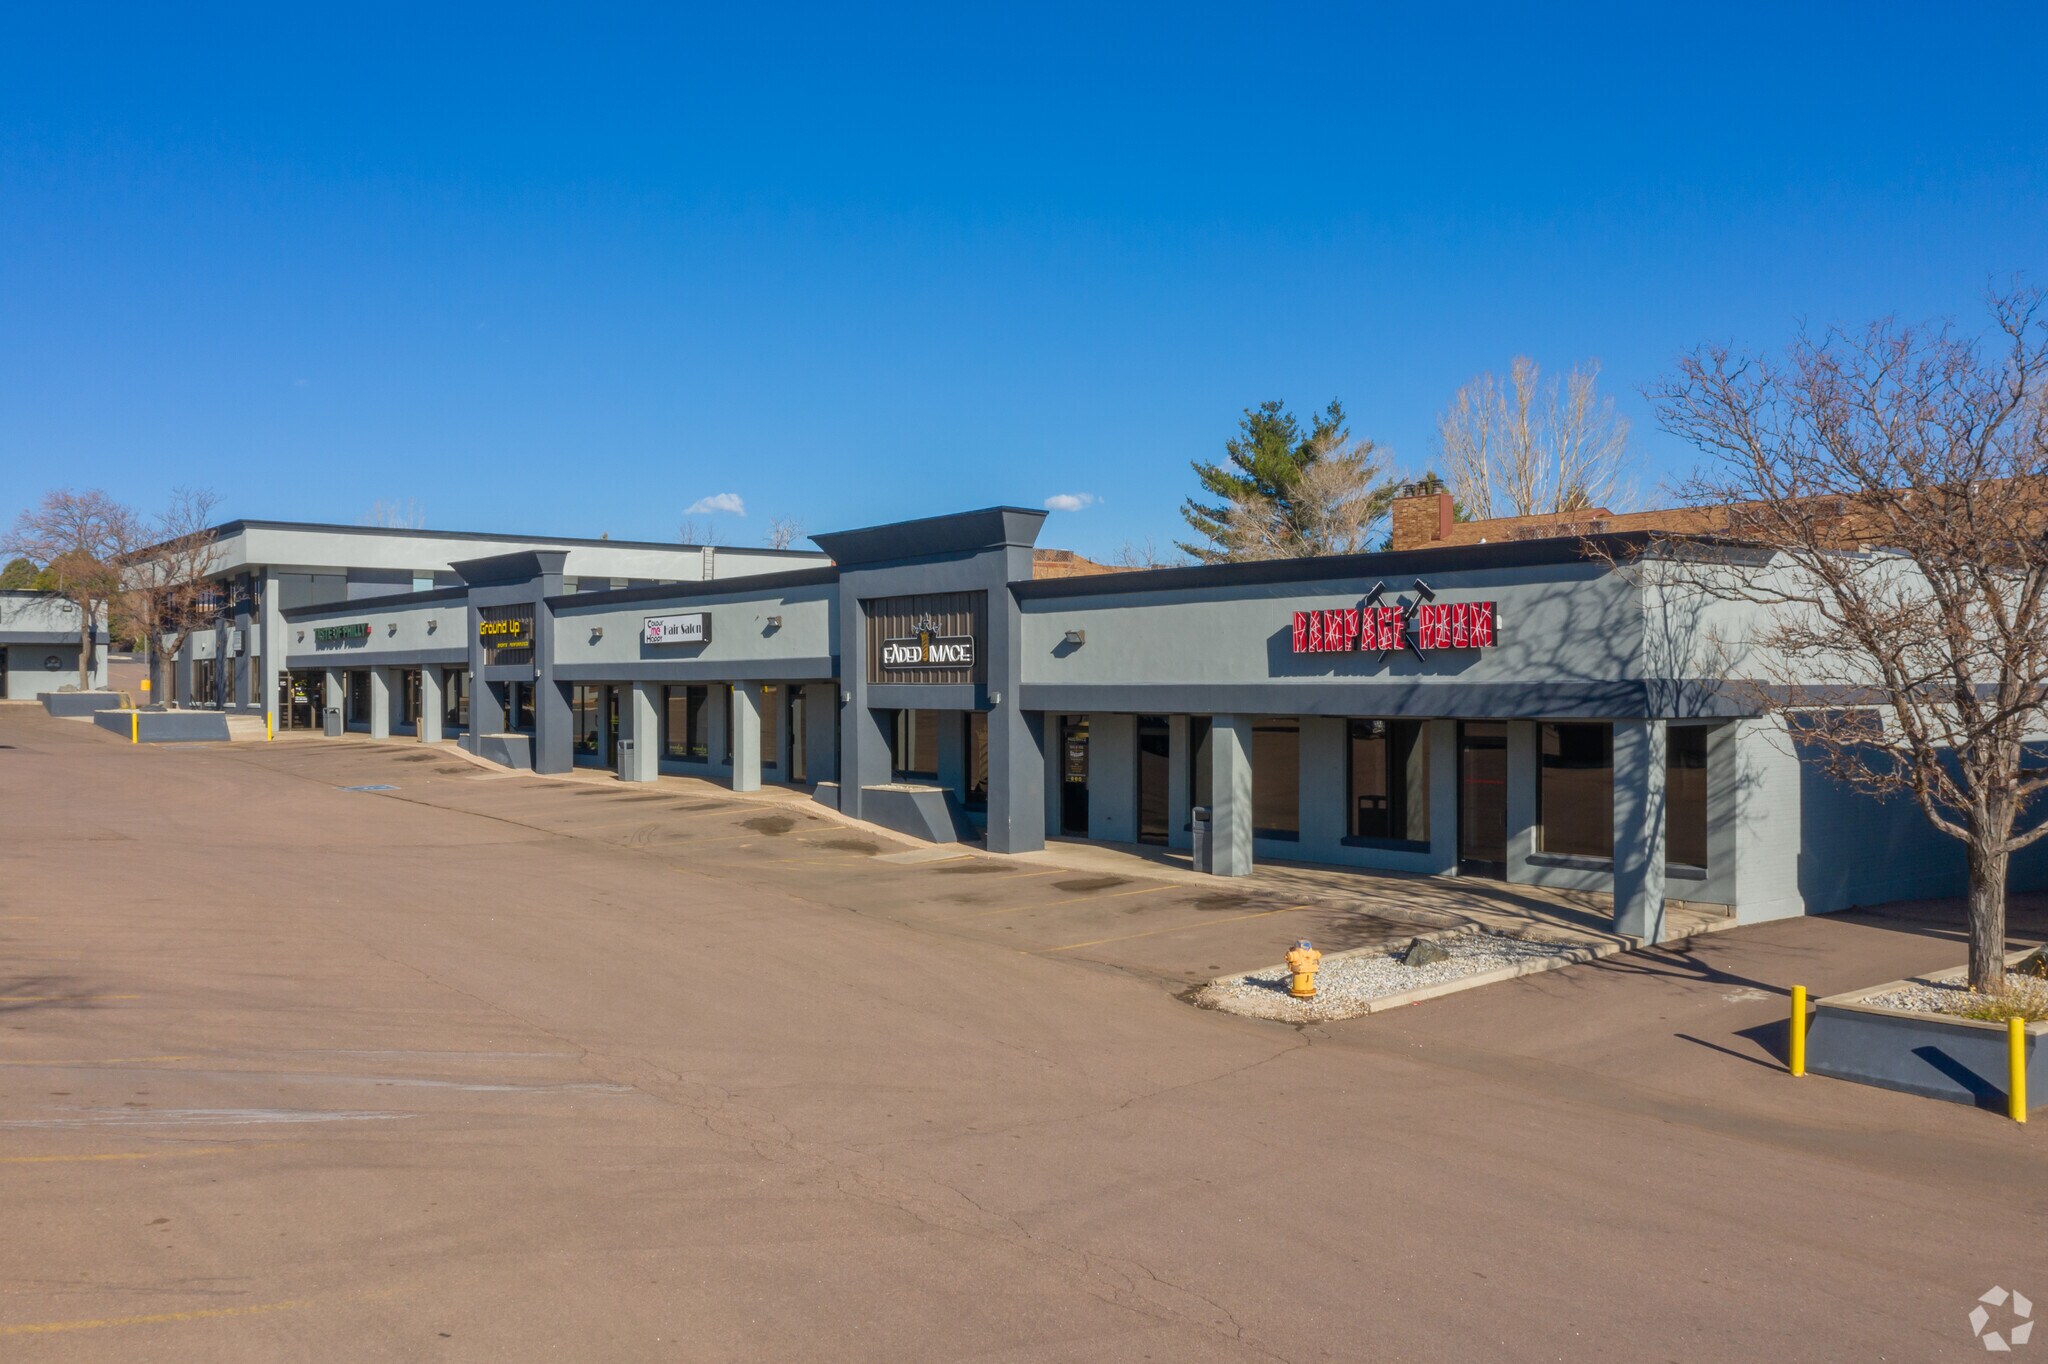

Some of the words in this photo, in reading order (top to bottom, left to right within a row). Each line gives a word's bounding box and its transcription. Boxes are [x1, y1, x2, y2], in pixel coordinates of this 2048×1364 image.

[313, 627, 333, 641] TASTE
[343, 623, 367, 638] PHILLY
[480, 619, 507, 635] Ground
[509, 618, 520, 637] Up
[681, 623, 702, 635] Salon
[1293, 606, 1406, 653] RAMPAGE
[1419, 601, 1493, 649] ROOM
[883, 643, 922, 663] FADED
[929, 644, 971, 663] IMAGE
